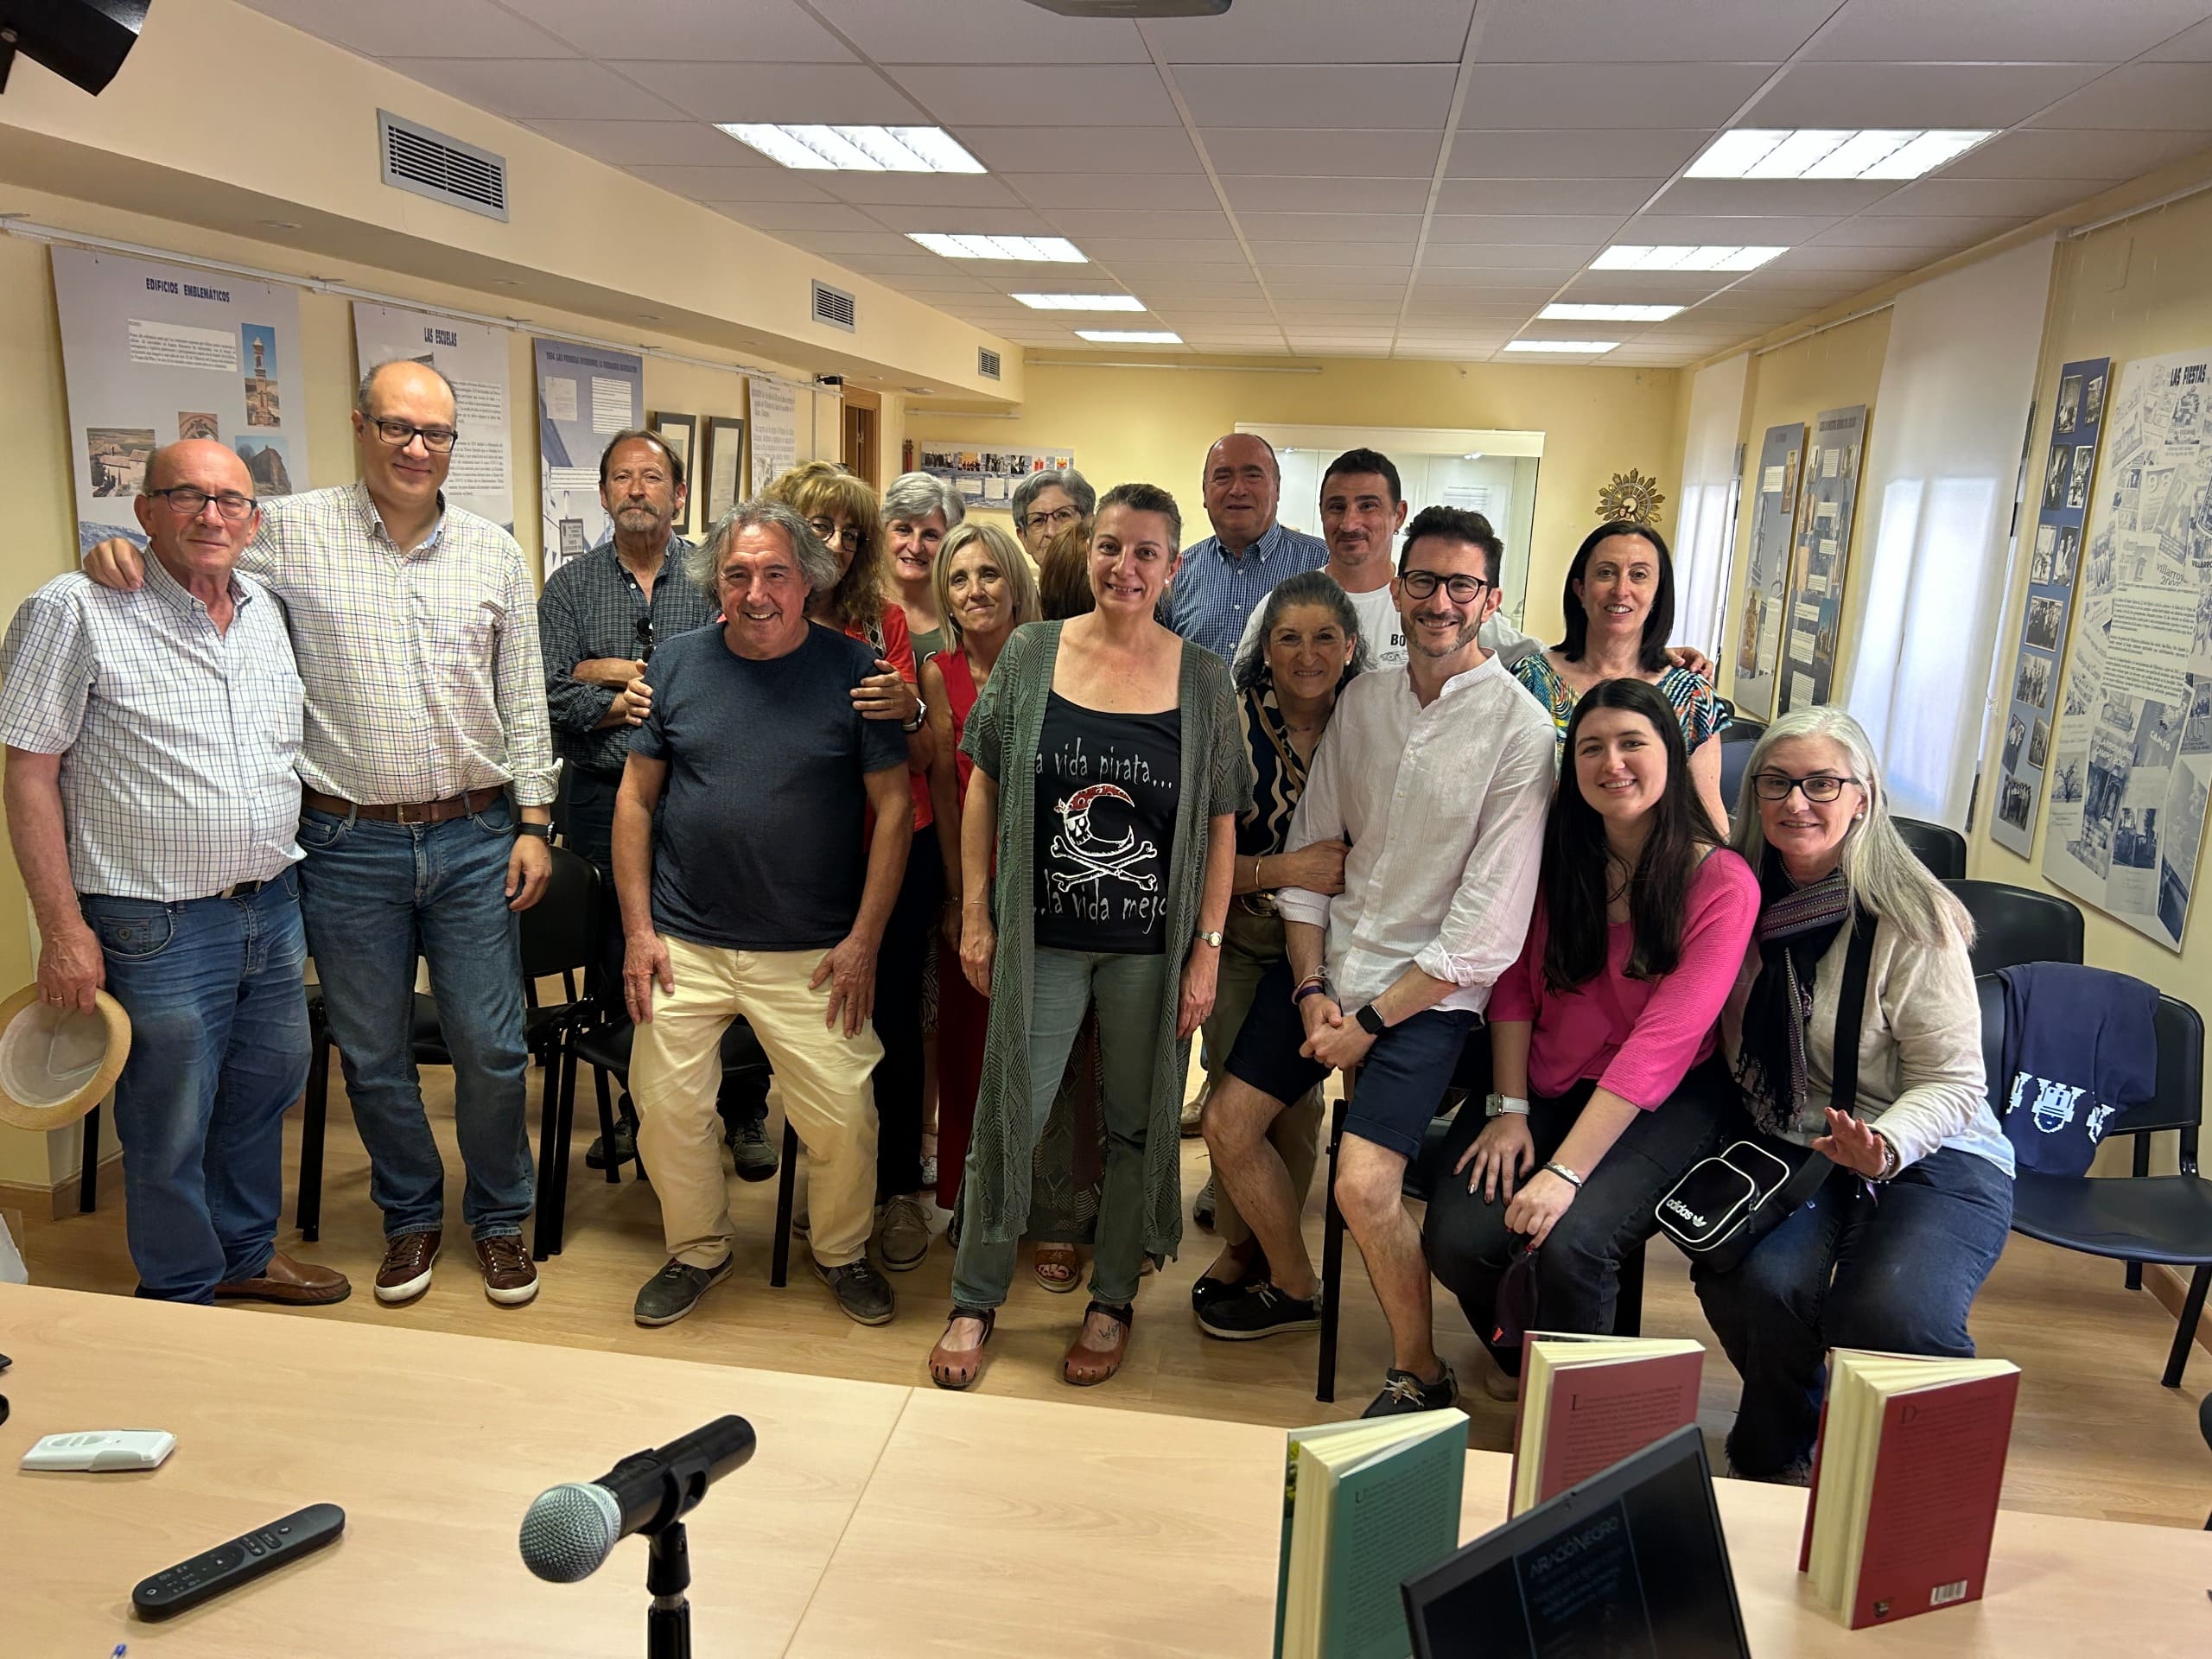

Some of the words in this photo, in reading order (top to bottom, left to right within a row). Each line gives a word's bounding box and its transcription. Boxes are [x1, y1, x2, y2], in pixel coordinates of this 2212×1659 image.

[145, 277, 179, 295] EDIFICIOS
[183, 283, 231, 302] EMBLEMÁTICOS
[424, 327, 434, 343] LAS
[435, 328, 457, 347] ESCUELAS
[2170, 367, 2182, 387] LAS
[2183, 364, 2207, 385] FIESTAS
[1054, 737, 1088, 779] vida
[1072, 878, 1109, 925] vida
[1666, 1198, 1694, 1220] adidas
